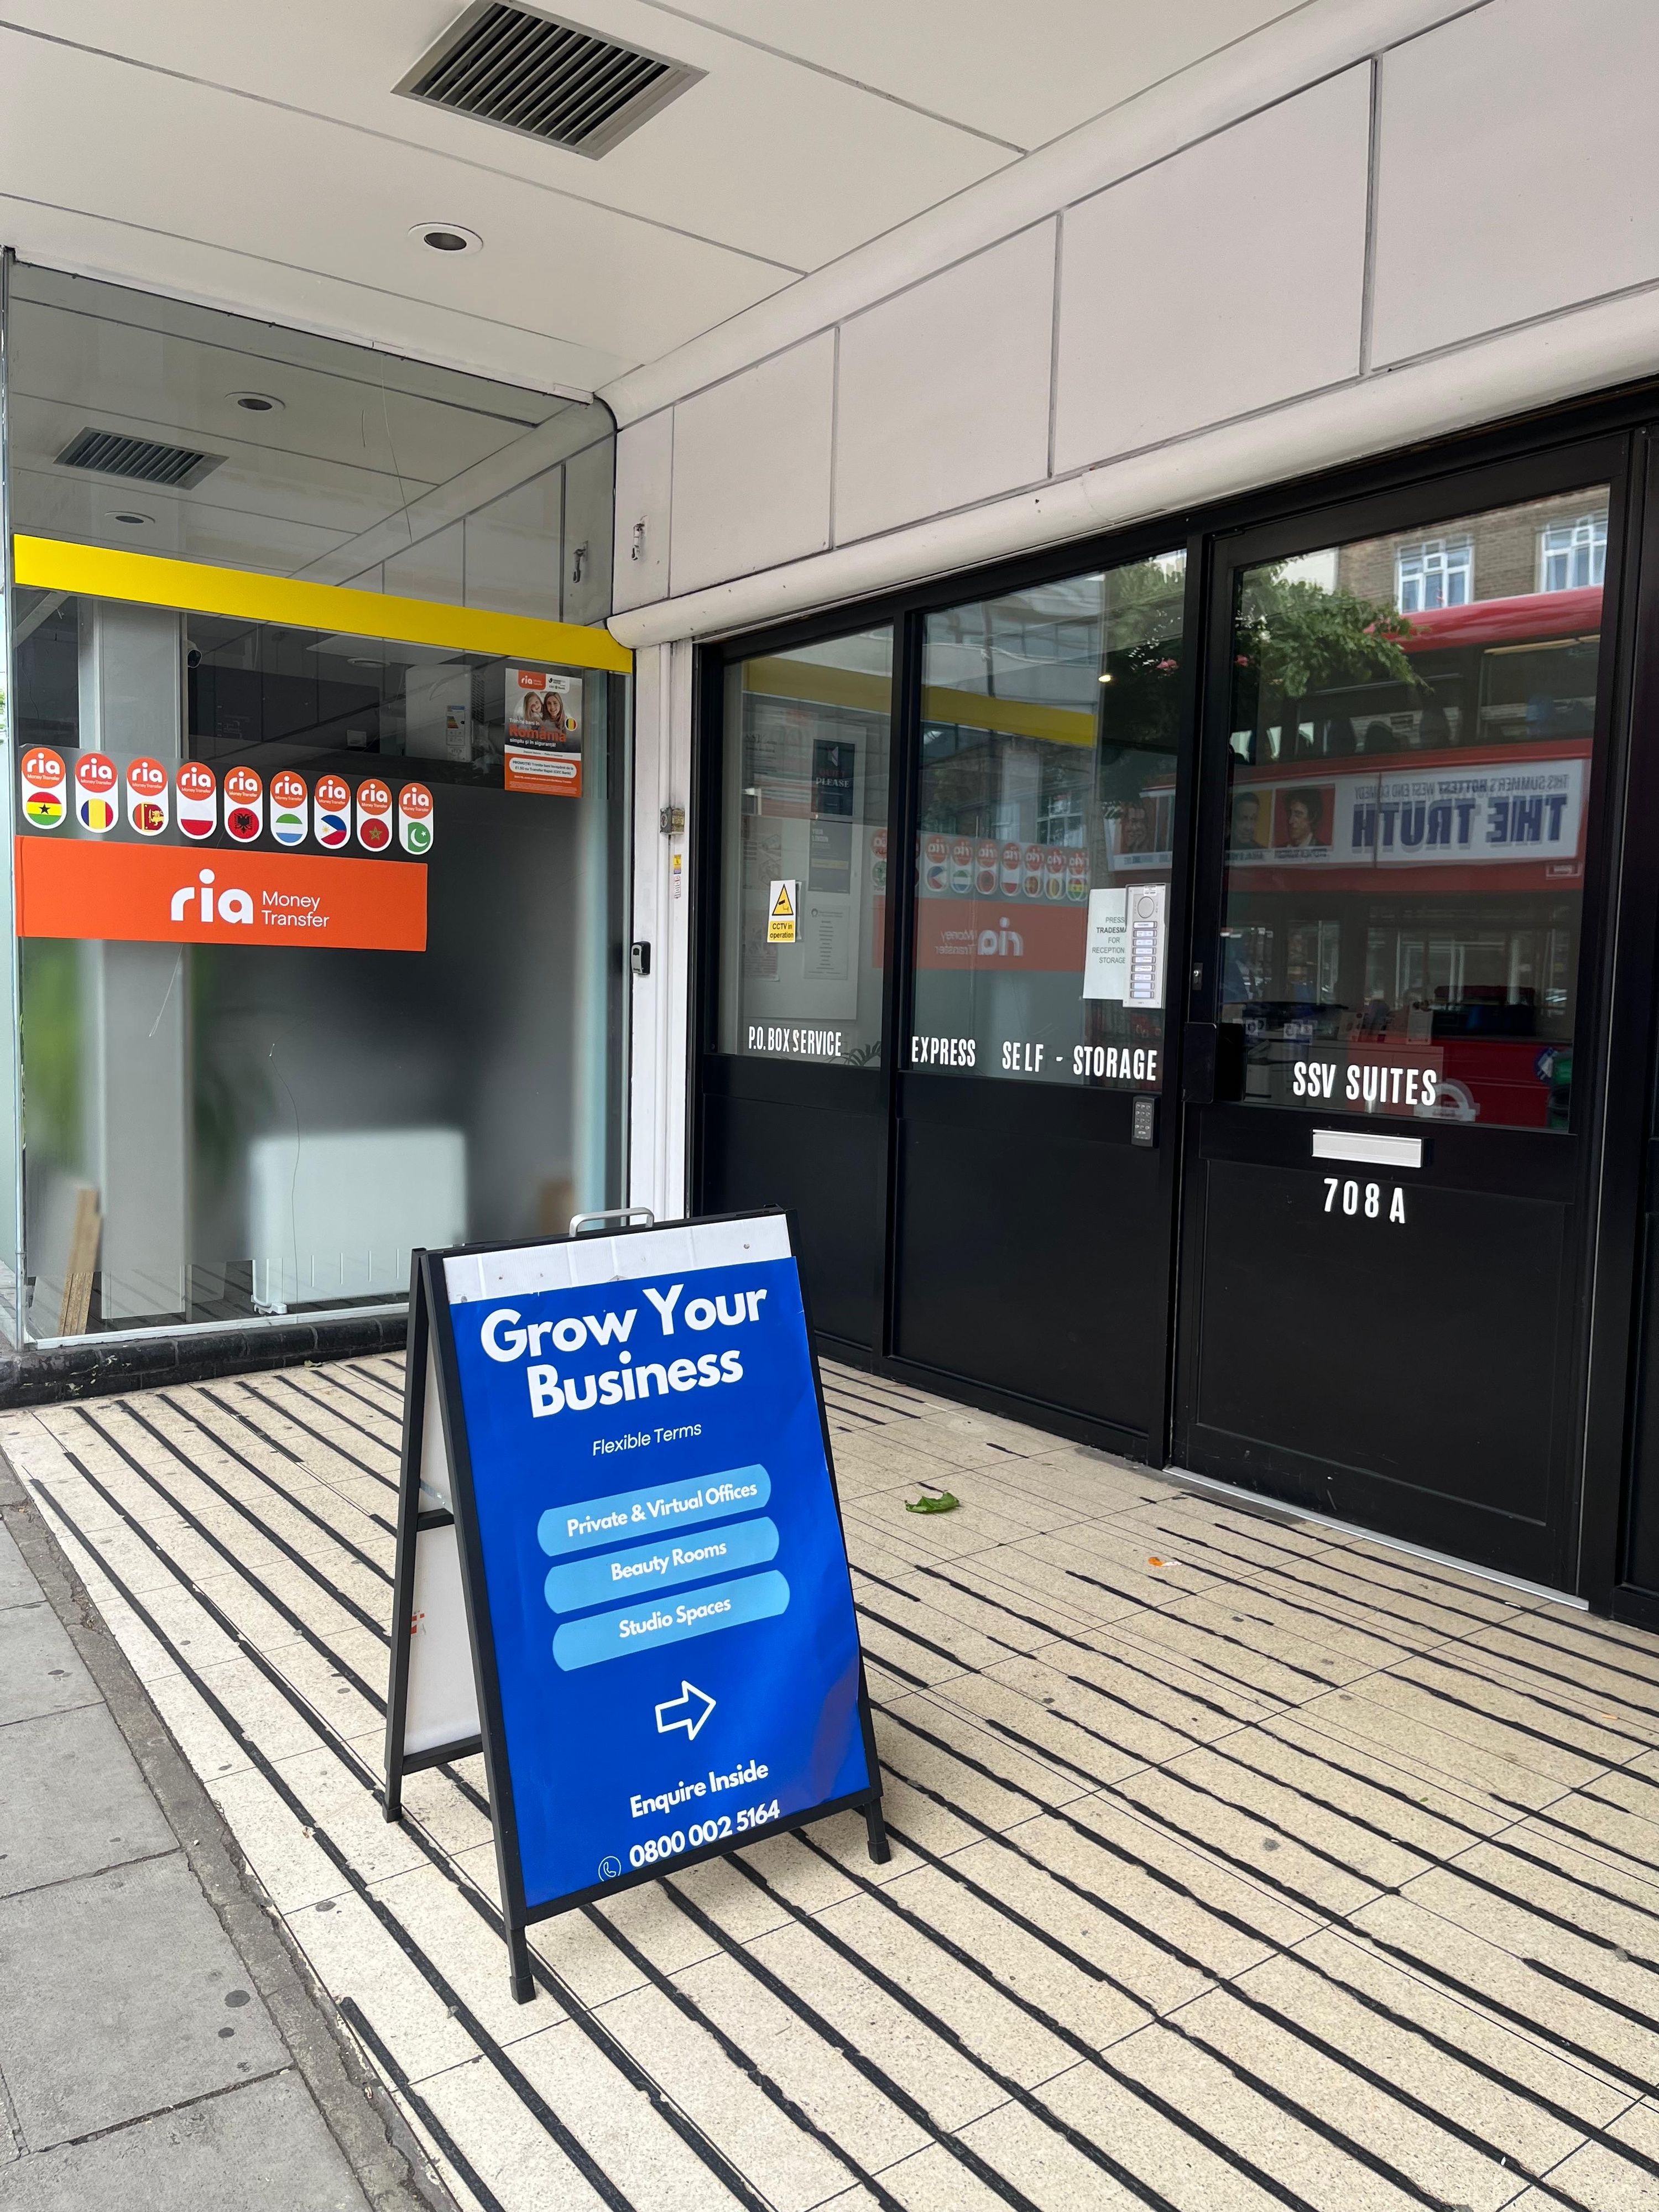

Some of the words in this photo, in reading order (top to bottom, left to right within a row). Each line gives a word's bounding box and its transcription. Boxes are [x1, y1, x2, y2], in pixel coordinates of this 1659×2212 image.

[521, 675, 533, 685] ria
[27, 752, 60, 775] ria
[80, 758, 112, 779] ria
[132, 761, 163, 783] ria
[181, 766, 211, 787] ria
[228, 771, 258, 791] ria
[275, 776, 303, 796] ria
[816, 776, 850, 788] PLEASE
[319, 779, 346, 799] ria
[361, 783, 388, 803] ria
[403, 787, 429, 806] ria
[171, 868, 254, 924] ria
[263, 890, 321, 911] Money
[262, 910, 330, 928] Transfer
[748, 1026, 766, 1050] P.O.
[768, 1027, 790, 1052] BOX
[792, 1029, 842, 1057] SERVICE
[911, 1036, 976, 1067] EXPRESS
[1002, 1041, 1044, 1072] SELF
[1073, 1045, 1157, 1082] STORAGE
[1292, 1061, 1336, 1098] SSV
[1345, 1065, 1437, 1106] SUITES
[480, 1307, 638, 1363] Grow
[643, 1283, 768, 1336] Your
[526, 1349, 743, 1418] Business
[592, 1431, 651, 1456] Flexible
[654, 1422, 702, 1443] Terms
[567, 1512, 628, 1537] Private
[631, 1504, 646, 1522] &
[646, 1490, 703, 1519] Virtual
[705, 1483, 758, 1505] Offices
[611, 1555, 670, 1581] Beauty
[672, 1542, 727, 1566] Rooms
[619, 1611, 673, 1638] Studio
[676, 1598, 732, 1626] Spaces
[630, 1781, 707, 1818] Enquire
[708, 1759, 769, 1792] Inside
[629, 1830, 686, 1868] 0800
[689, 1816, 733, 1848] 002
[737, 1799, 780, 1833] 5164
